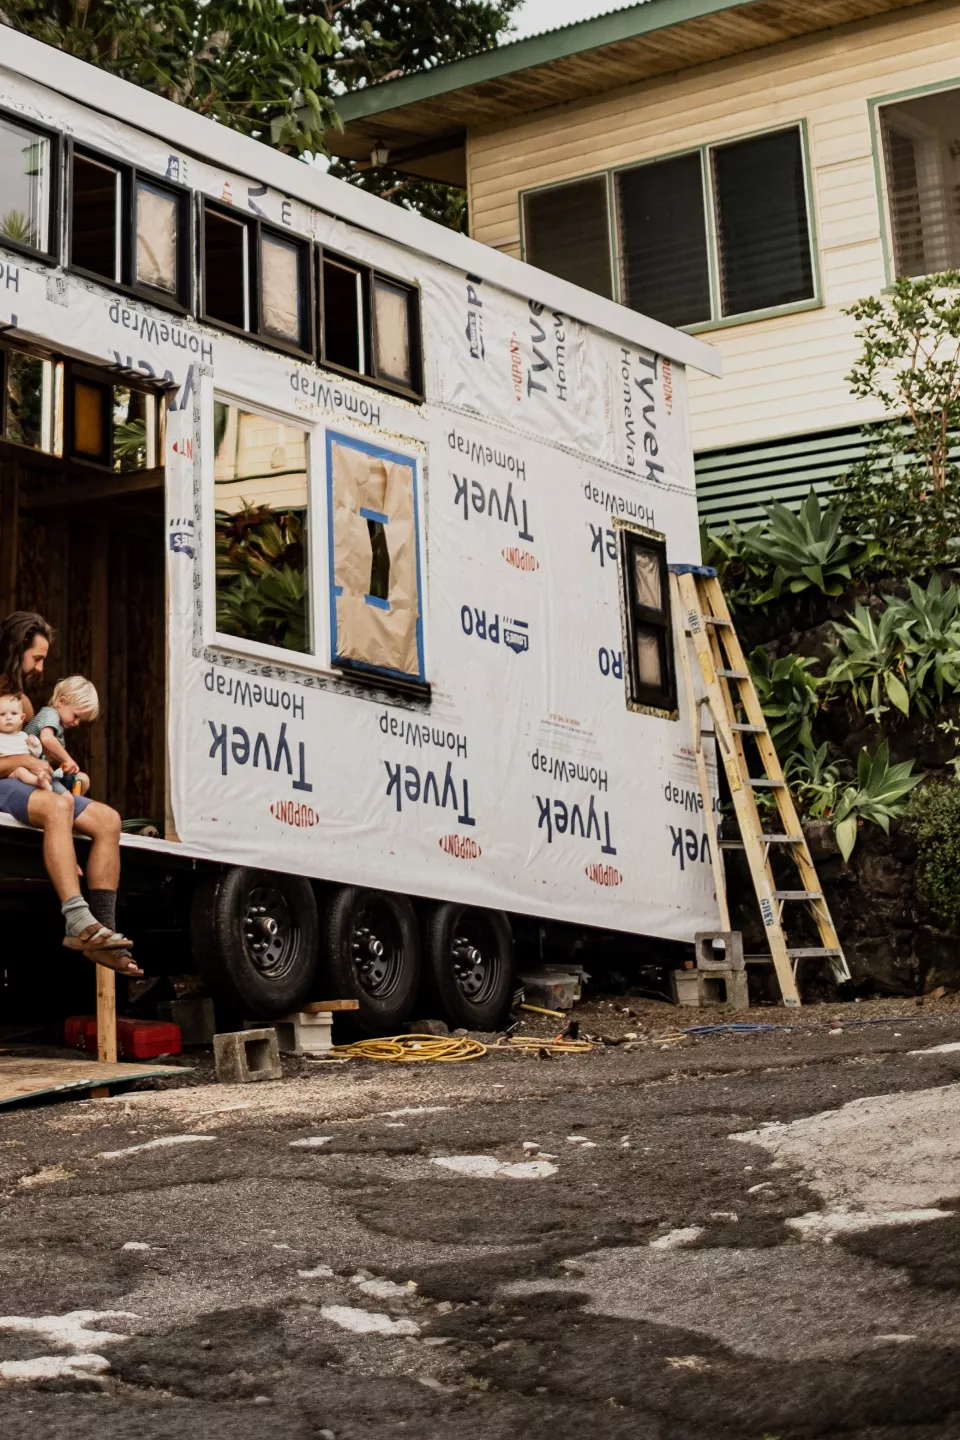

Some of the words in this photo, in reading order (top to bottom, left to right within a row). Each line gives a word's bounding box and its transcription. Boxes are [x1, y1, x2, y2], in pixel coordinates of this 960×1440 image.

[108, 301, 213, 364] HomeWrap
[527, 299, 554, 398] Tyve
[290, 369, 380, 426] HomeWrap
[634, 353, 665, 483] Tyvek
[448, 428, 526, 481] HomeWrap
[452, 473, 534, 543] Tyvek
[584, 480, 655, 528] HomeWrap
[460, 605, 500, 644] PRO
[598, 646, 623, 680] RO
[204, 667, 305, 720] HomeWrap
[208, 720, 313, 793] Tyvek
[379, 710, 468, 759] HomeWrap
[384, 760, 476, 827] Tyvek
[531, 748, 608, 792] HomeWrap
[276, 800, 314, 828] DUPONT
[536, 795, 617, 855] Tyvek
[444, 834, 479, 859] DUPONT
[589, 863, 620, 887] DUPONT
